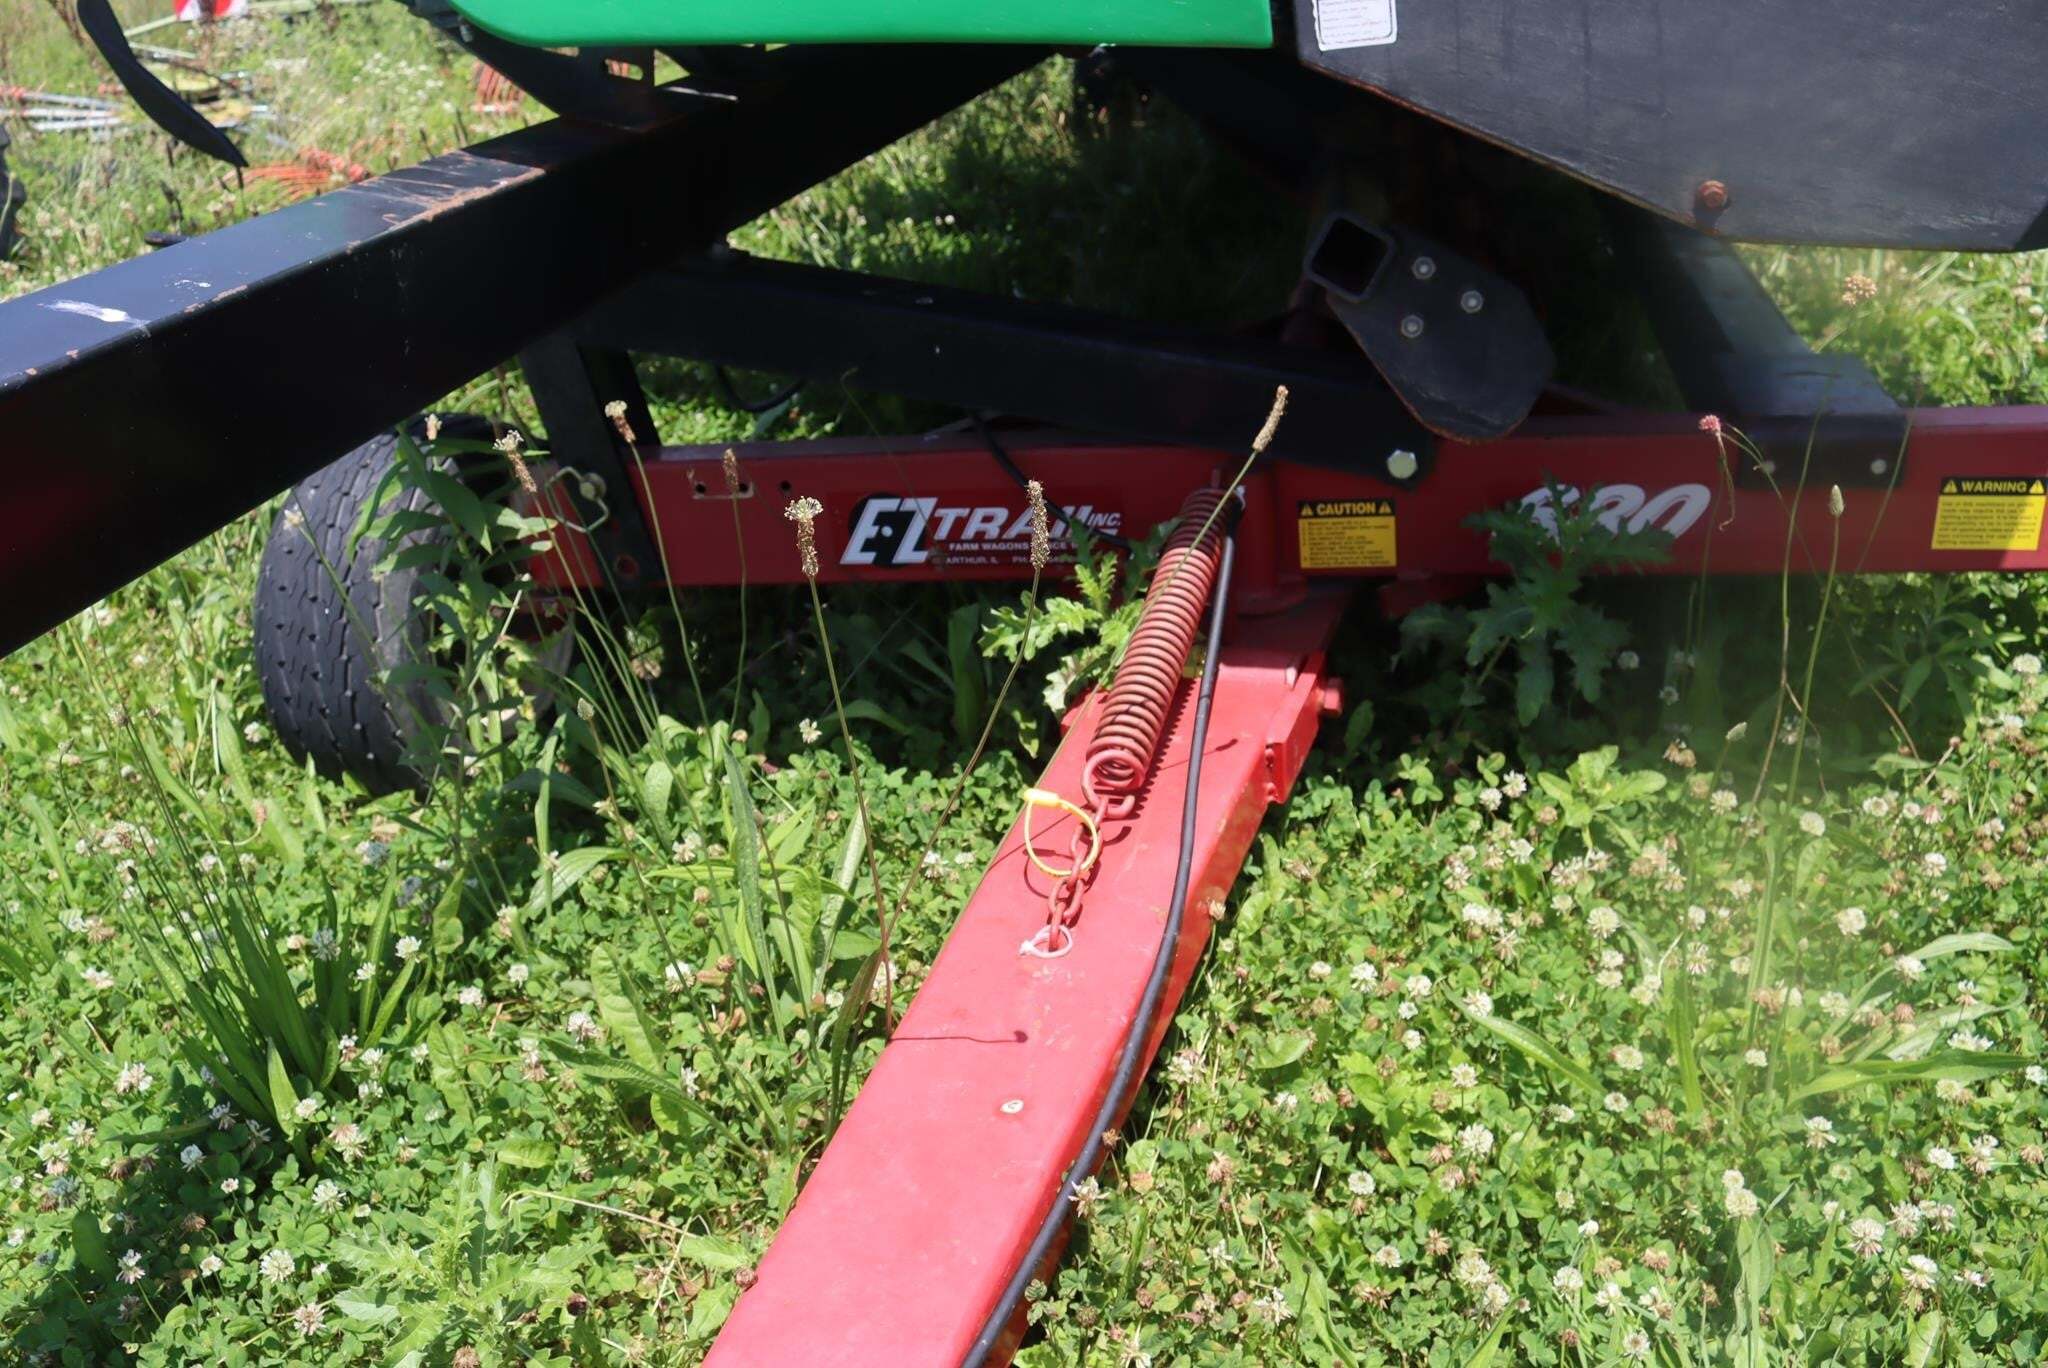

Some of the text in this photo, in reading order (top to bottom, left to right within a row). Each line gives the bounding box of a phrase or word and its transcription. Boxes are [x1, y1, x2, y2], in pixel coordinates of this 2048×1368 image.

[1961, 480, 2027, 493] WARNING
[1316, 502, 1376, 516] CAUTION
[949, 542, 979, 551] FARM
[981, 541, 1029, 551] WAGONS
